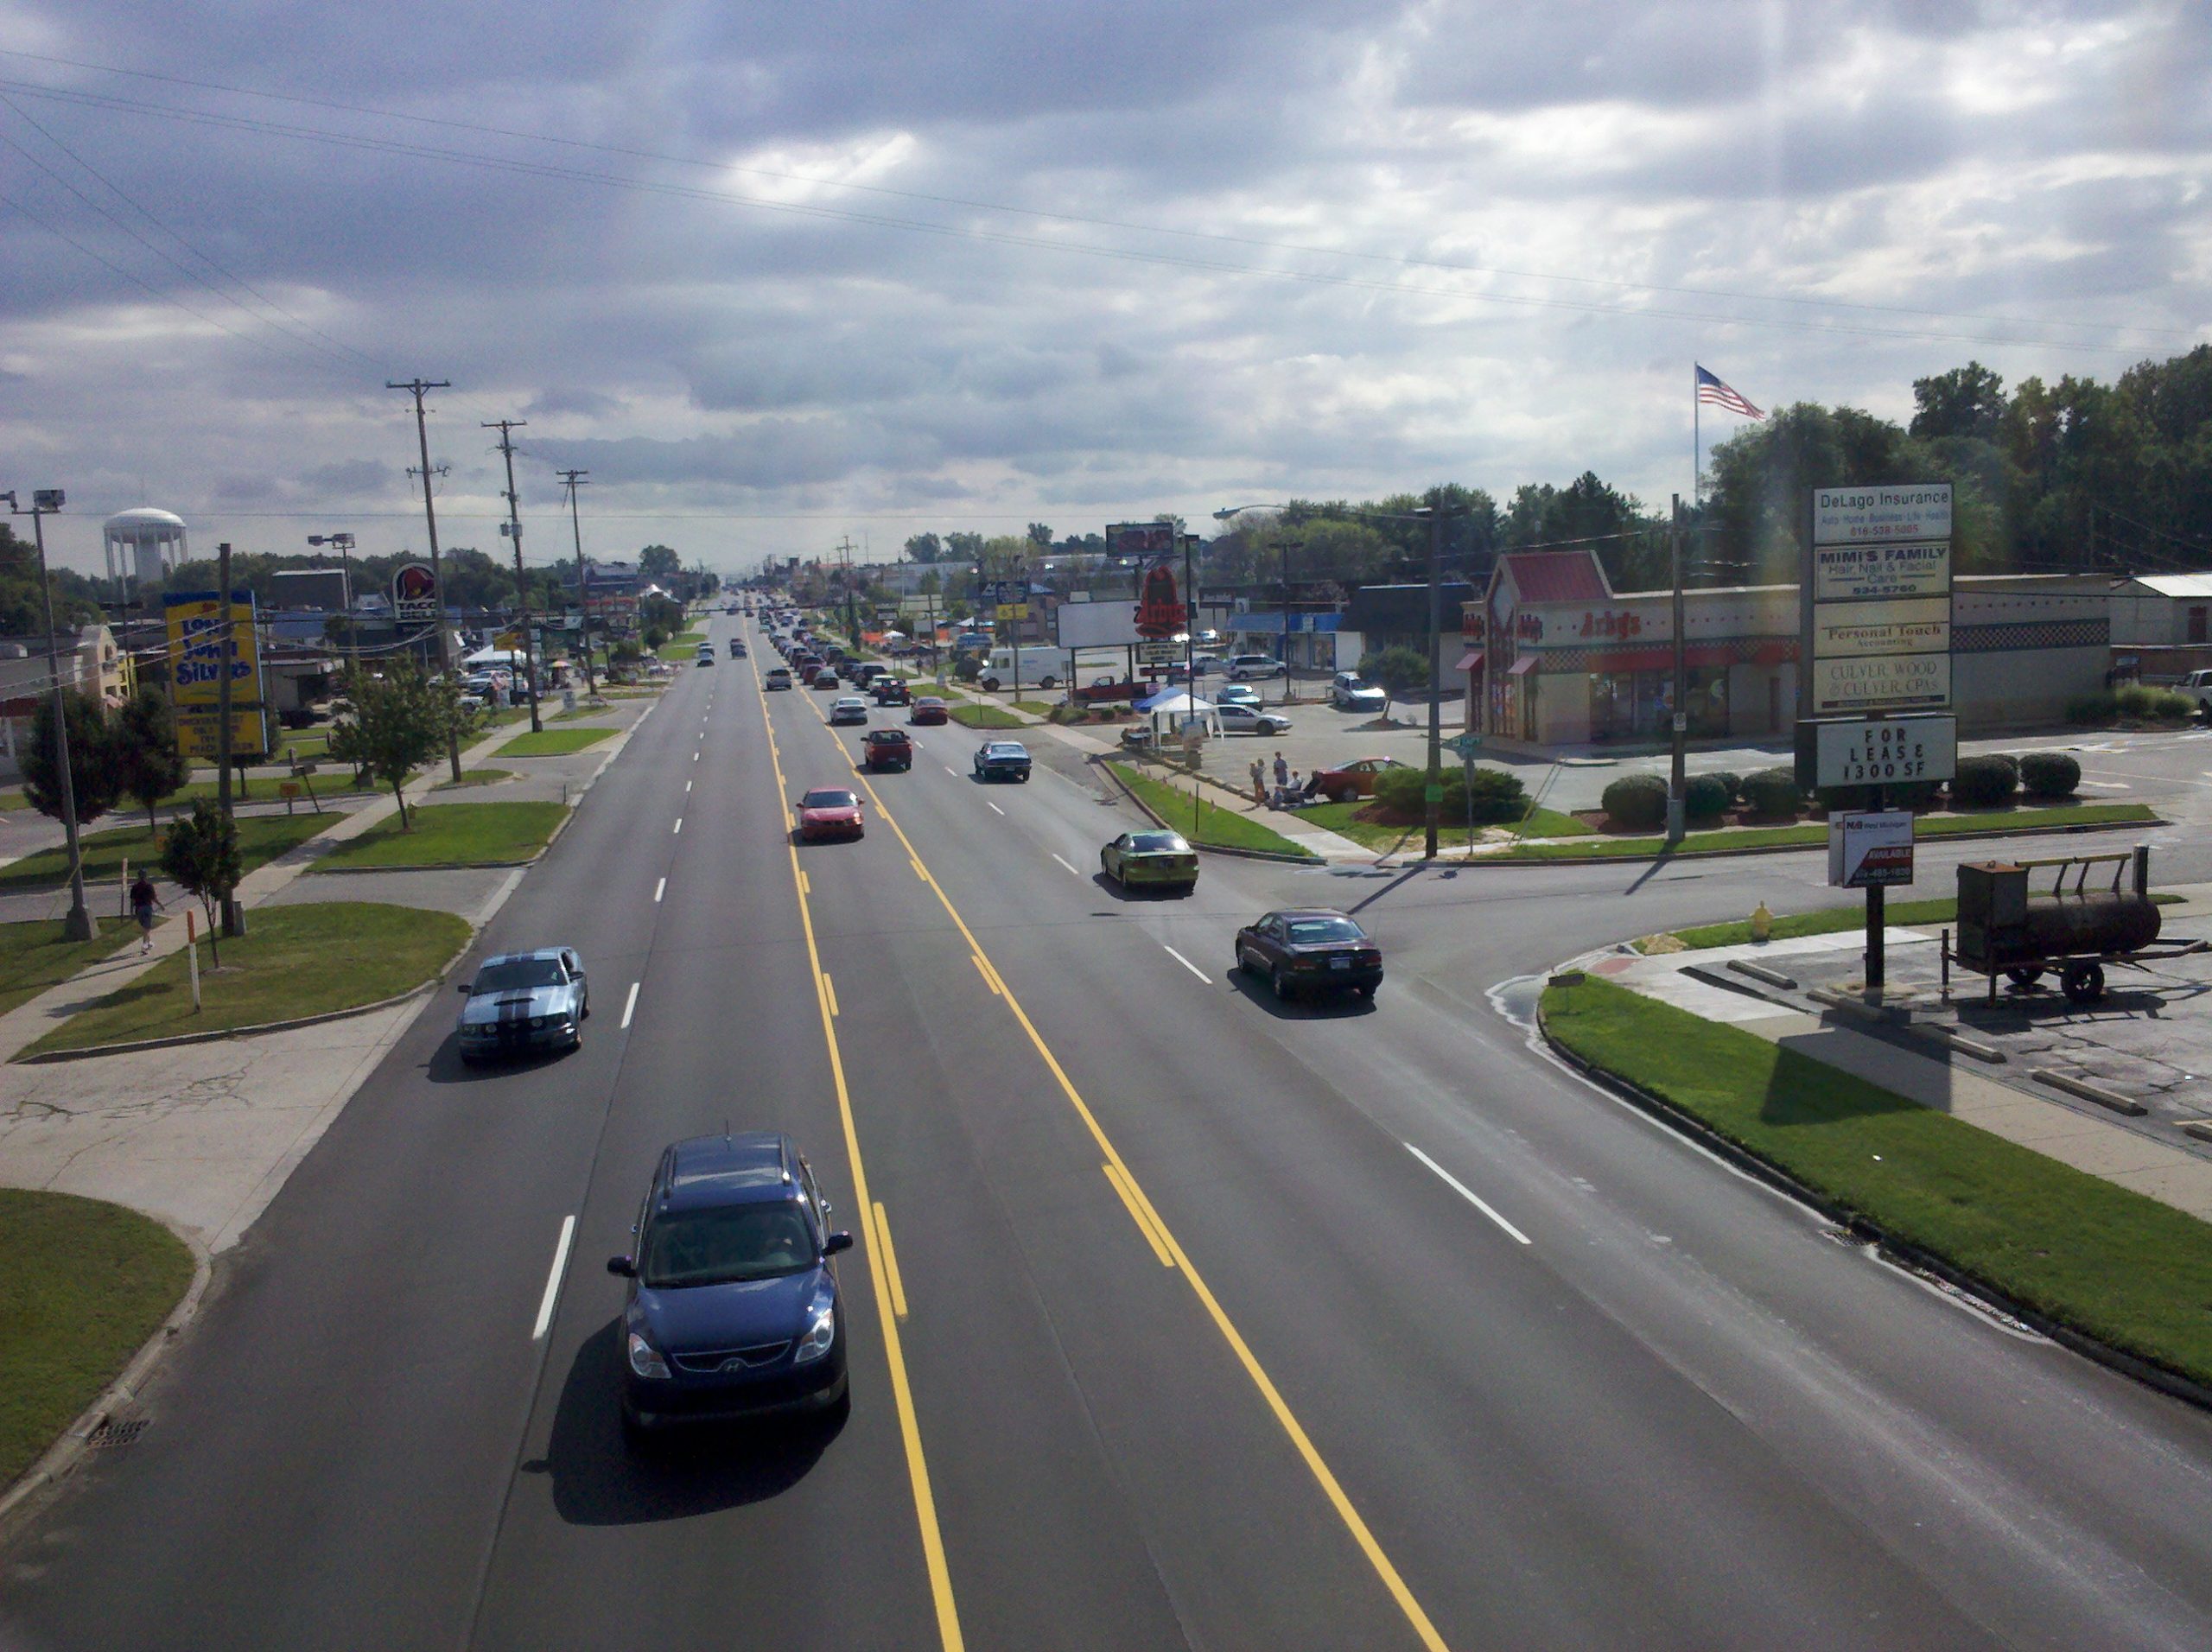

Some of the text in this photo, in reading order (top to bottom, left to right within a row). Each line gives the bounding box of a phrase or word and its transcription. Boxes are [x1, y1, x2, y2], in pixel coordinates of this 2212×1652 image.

[1821, 492, 1948, 510] DeLago Insurance
[1821, 548, 1947, 563] MIMI'S FAMILY
[1859, 562, 1882, 574] Nail
[1887, 562, 1895, 572] &
[1901, 560, 1936, 571] Facial
[1867, 573, 1897, 584] Care
[1828, 623, 1941, 640] Personal Touch
[1895, 660, 1937, 675] WOOD
[1865, 728, 1906, 743] FOR
[1849, 743, 1924, 762] LEASE
[1843, 761, 1925, 779] 1300 SF
